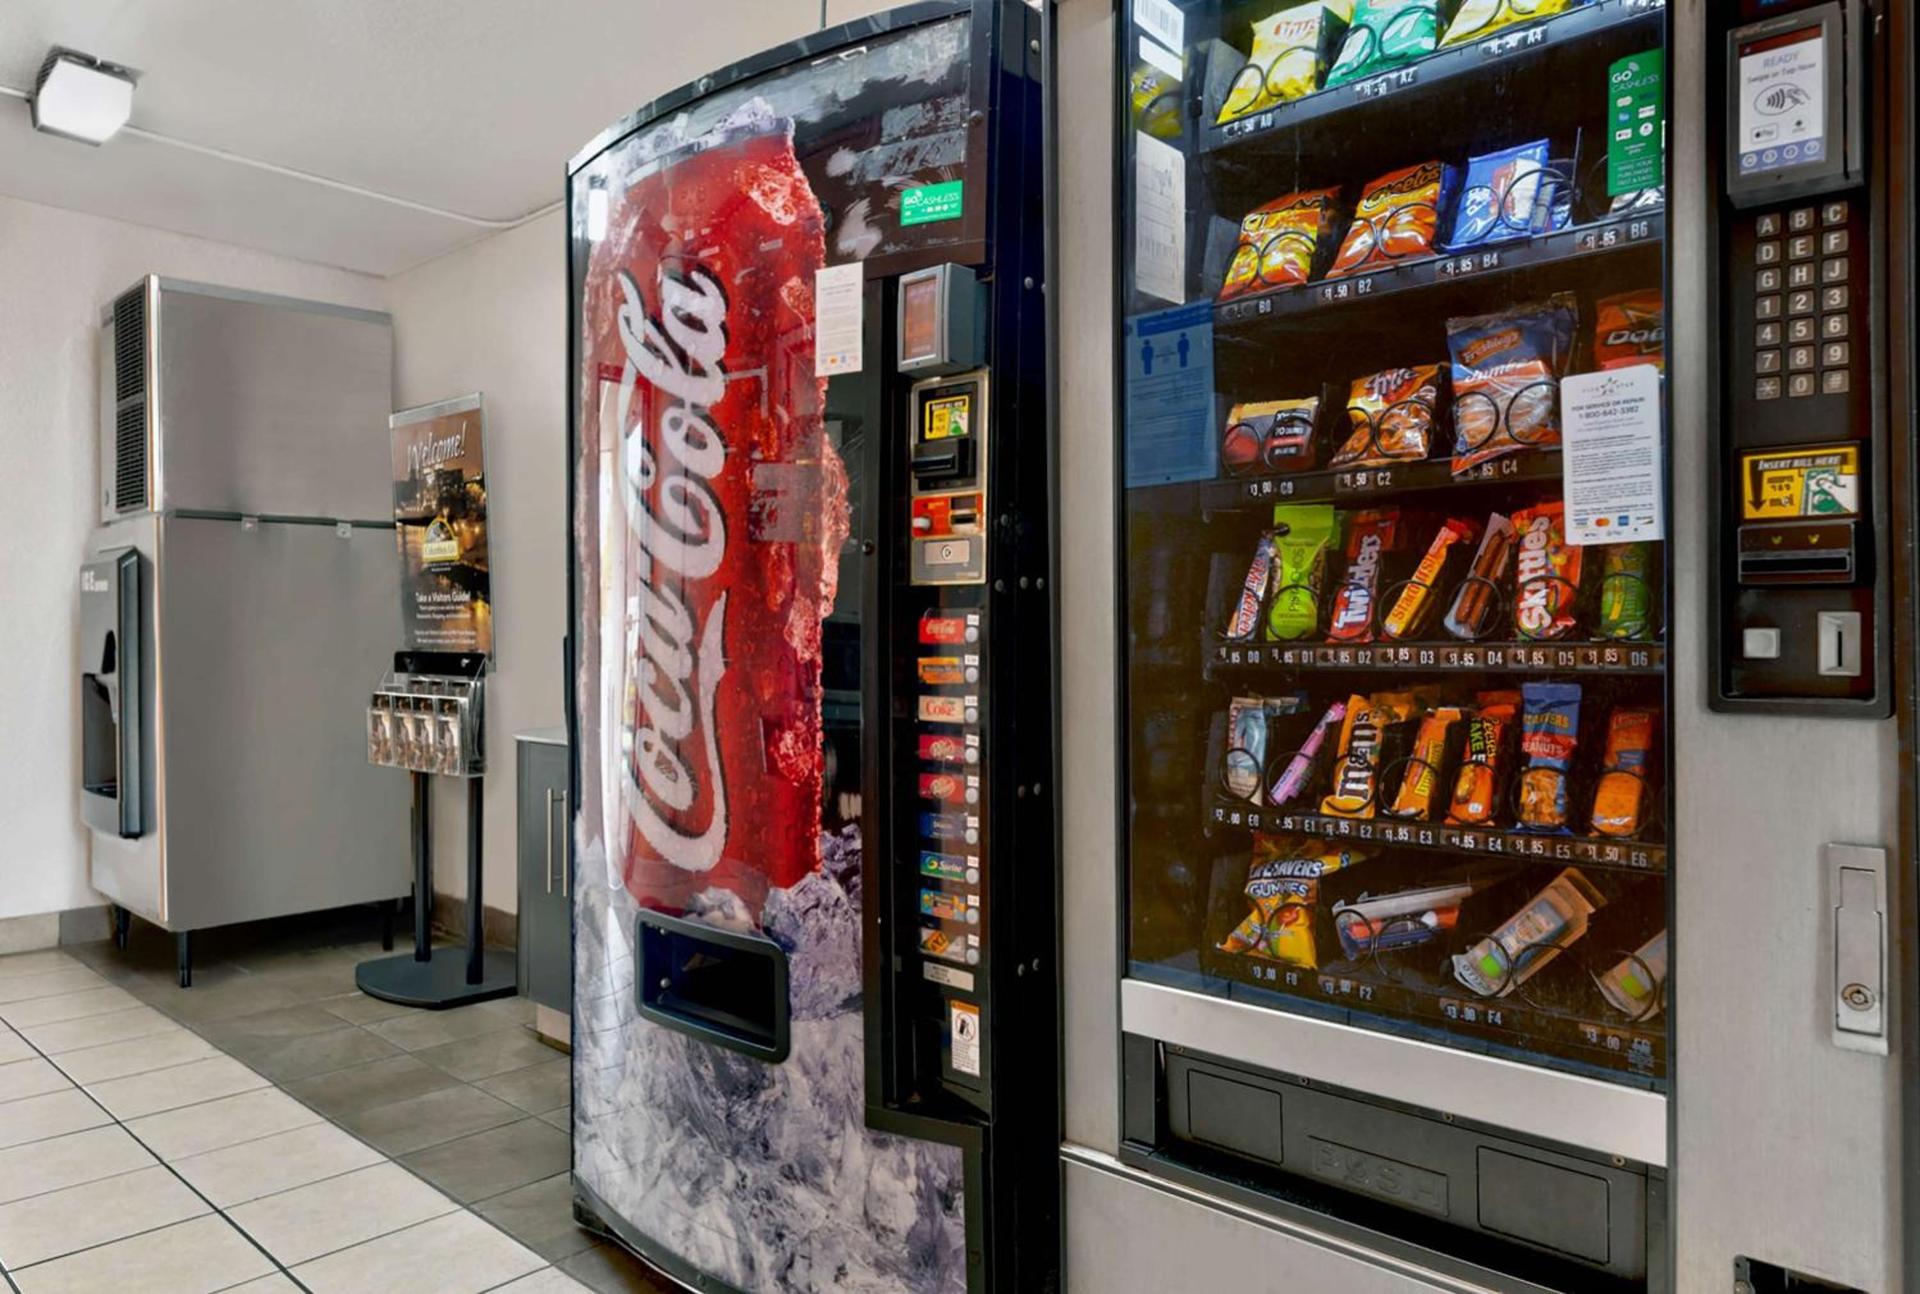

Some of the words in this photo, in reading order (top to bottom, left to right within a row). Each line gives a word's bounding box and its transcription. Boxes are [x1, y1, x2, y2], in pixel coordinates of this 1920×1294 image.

[1763, 51, 1799, 68] READY
[1612, 70, 1632, 83] GO
[1612, 74, 1660, 92] CASHLESS
[1794, 212, 1807, 229] B
[1828, 205, 1841, 222] C
[1631, 222, 1648, 237] B6
[1761, 217, 1774, 234] A
[1795, 239, 1806, 256] E
[1829, 233, 1840, 251] F
[1762, 245, 1773, 260] D
[1483, 253, 1499, 268] B4
[1795, 266, 1807, 283] H
[1828, 261, 1840, 278] J
[1358, 279, 1372, 295] B2
[1762, 271, 1773, 288] G
[1795, 294, 1807, 310] 2
[1829, 289, 1841, 305] 3
[1762, 299, 1771, 314] 1
[1795, 321, 1807, 337] 5
[1829, 317, 1841, 333] 6
[1761, 326, 1772, 340] 4
[1762, 353, 1773, 368] 7
[1795, 349, 1807, 365] 8
[1829, 345, 1841, 361] 9
[1795, 377, 1807, 392] 0
[407, 421, 466, 477] Welcome!
[1502, 460, 1518, 474] C4
[1758, 459, 1792, 471] INSERT
[1377, 472, 1391, 486] C2
[1558, 651, 1575, 666] D5
[1631, 652, 1648, 666] D6
[1360, 825, 1372, 839] E2
[1420, 830, 1432, 845] E3
[1488, 837, 1502, 851] E4
[1556, 844, 1571, 859] E5
[1631, 851, 1648, 868] E6
[1360, 985, 1372, 1000] F2
[1487, 1010, 1502, 1025] F4
